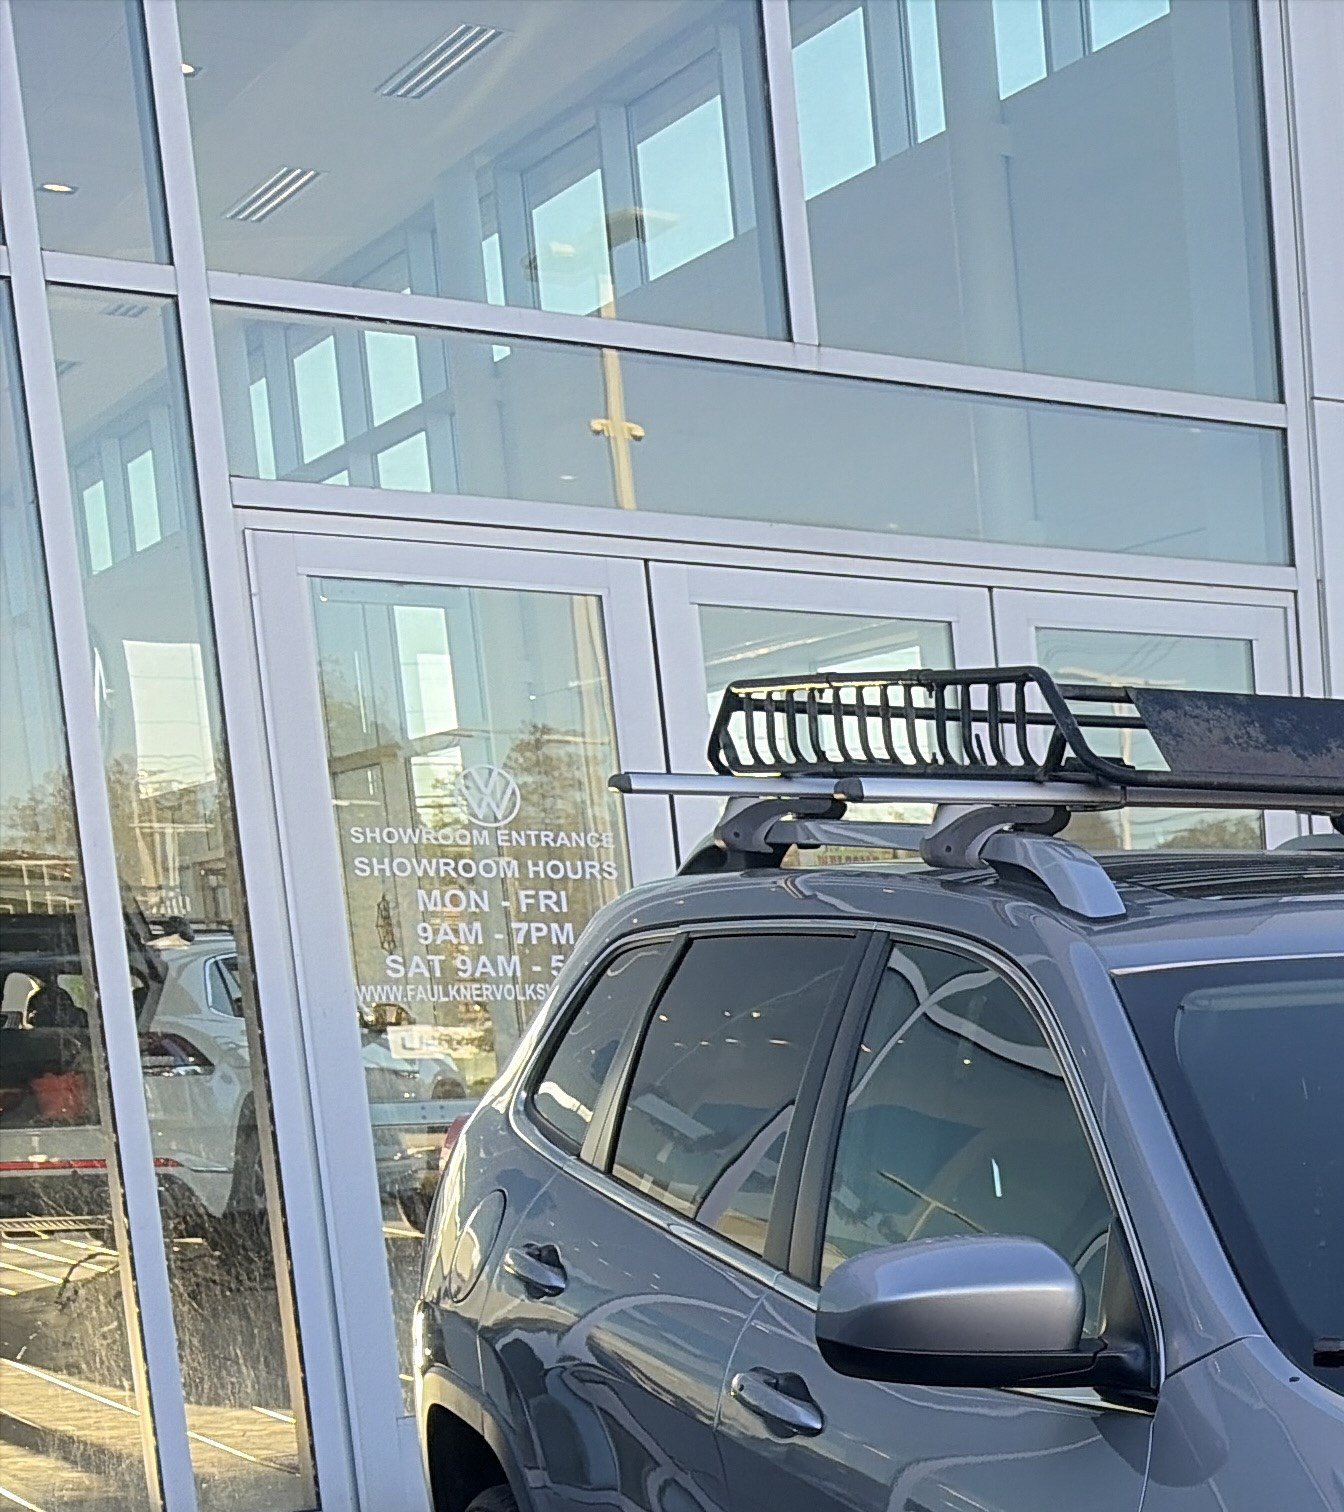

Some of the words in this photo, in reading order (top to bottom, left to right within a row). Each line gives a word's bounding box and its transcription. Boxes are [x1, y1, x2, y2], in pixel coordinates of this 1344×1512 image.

[350, 826, 490, 846] SHOWROOM
[498, 830, 615, 848] ENTRANCE
[354, 857, 519, 878] SHOWROOM
[528, 860, 619, 880] HOURS
[417, 889, 490, 912] MON
[520, 890, 568, 913] FRI
[417, 922, 483, 945] 9AM
[511, 922, 575, 945] 7PM
[385, 954, 445, 978] SAT
[456, 954, 521, 978] 9AM
[355, 983, 552, 1001] WWW.FAULKNERVOLKS
